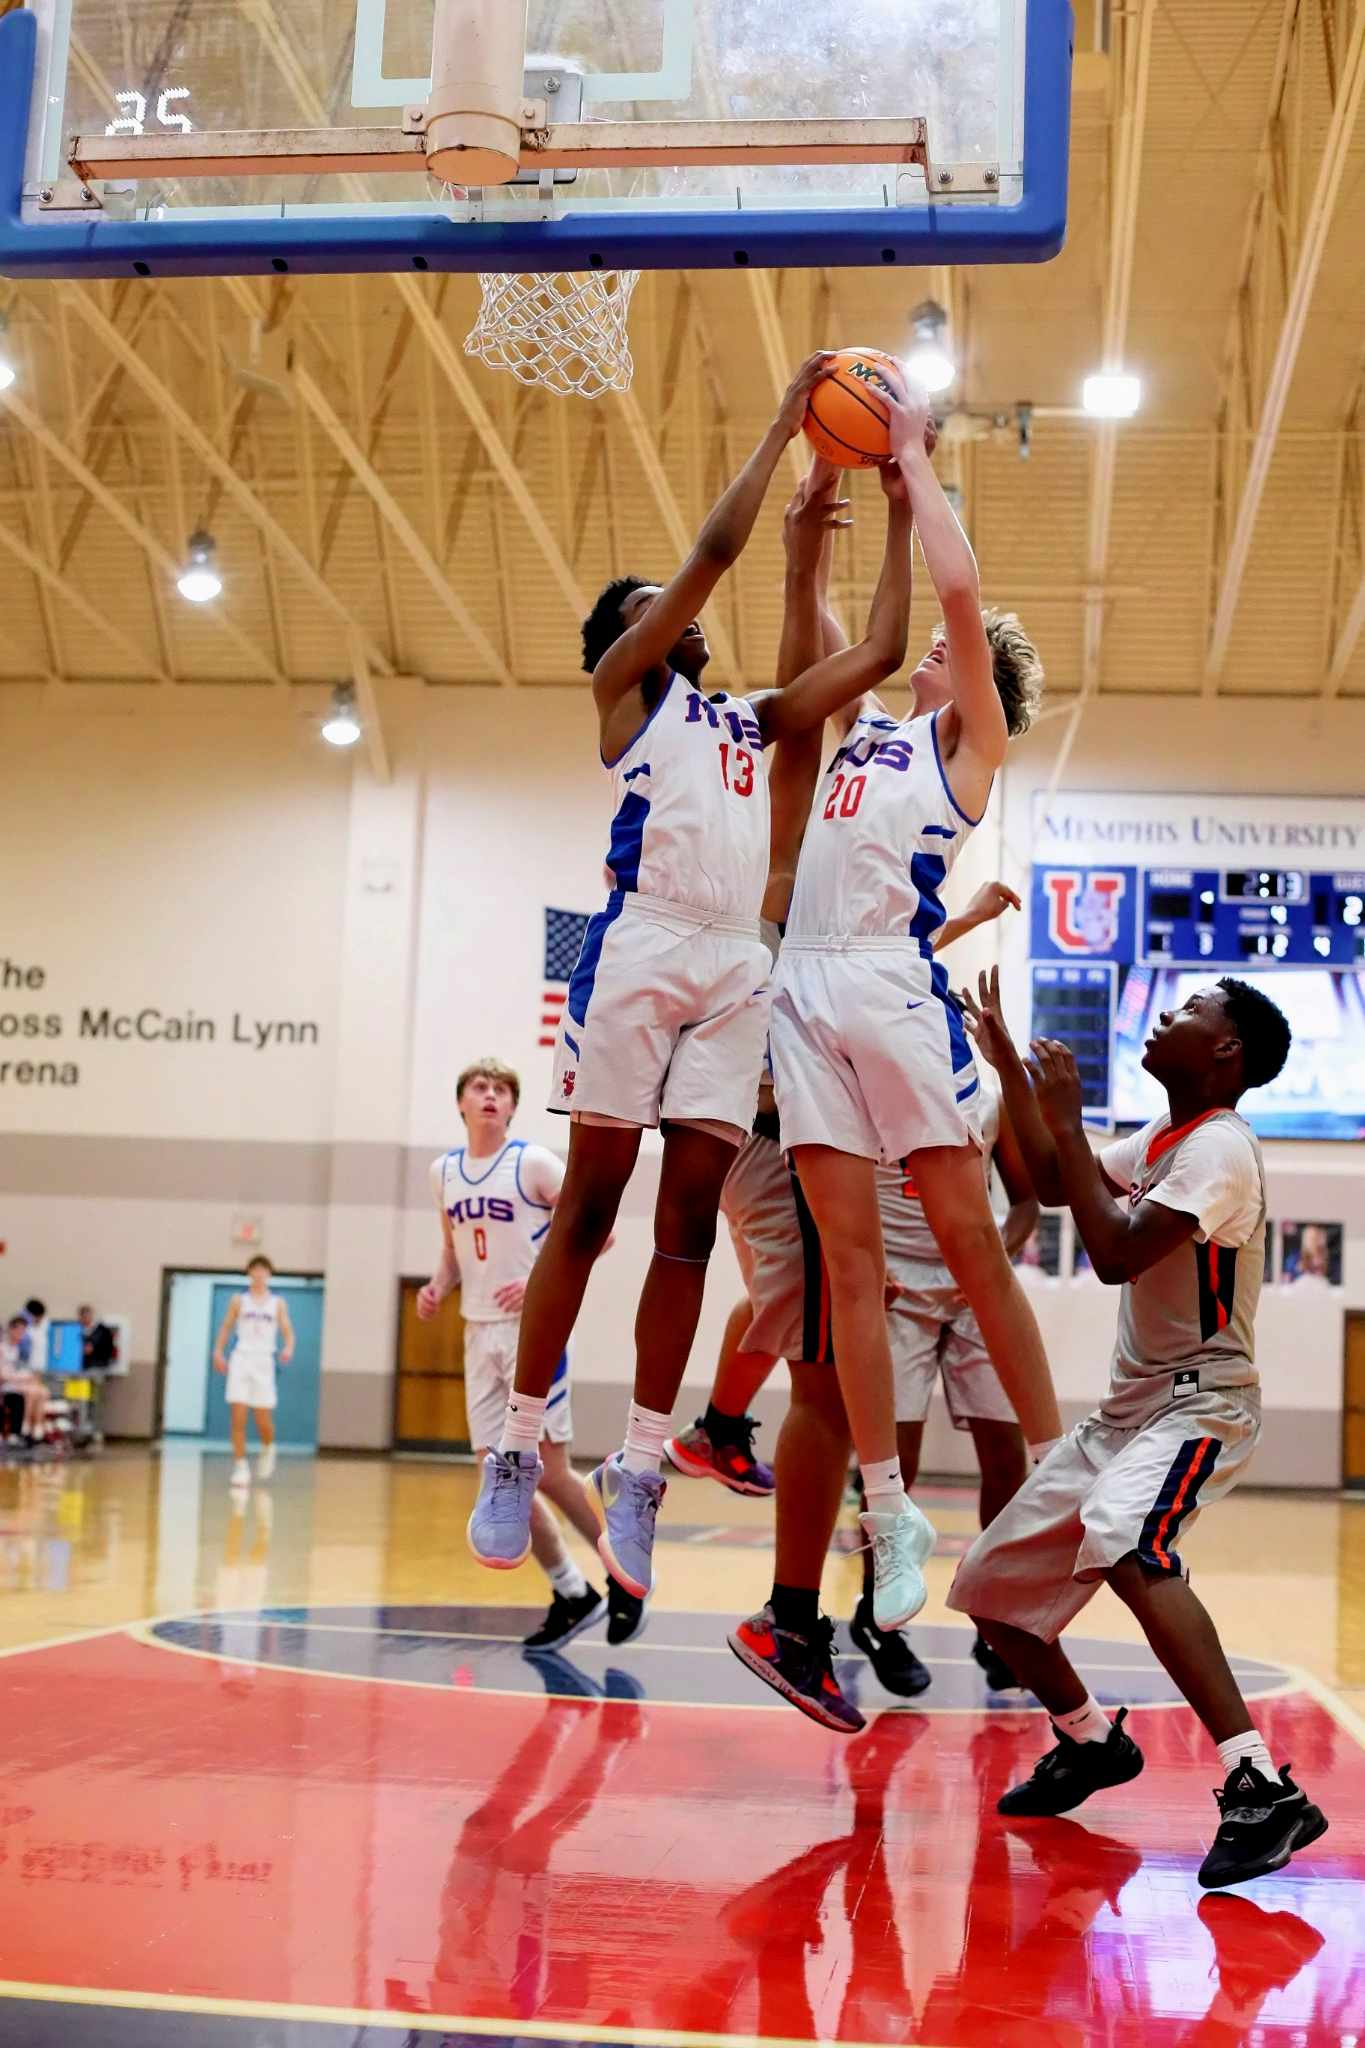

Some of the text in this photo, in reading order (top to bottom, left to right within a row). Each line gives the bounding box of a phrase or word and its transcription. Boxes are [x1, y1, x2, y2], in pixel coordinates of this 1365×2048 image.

[719, 743, 754, 797] 13
[823, 773, 867, 819] 20
[1044, 815, 1362, 848] MEMPHIS UNIVERSITY
[0, 957, 45, 990] he
[0, 1007, 319, 1050] oss McCain Lynn
[0, 1061, 79, 1086] rena
[474, 1228, 487, 1261] 0
